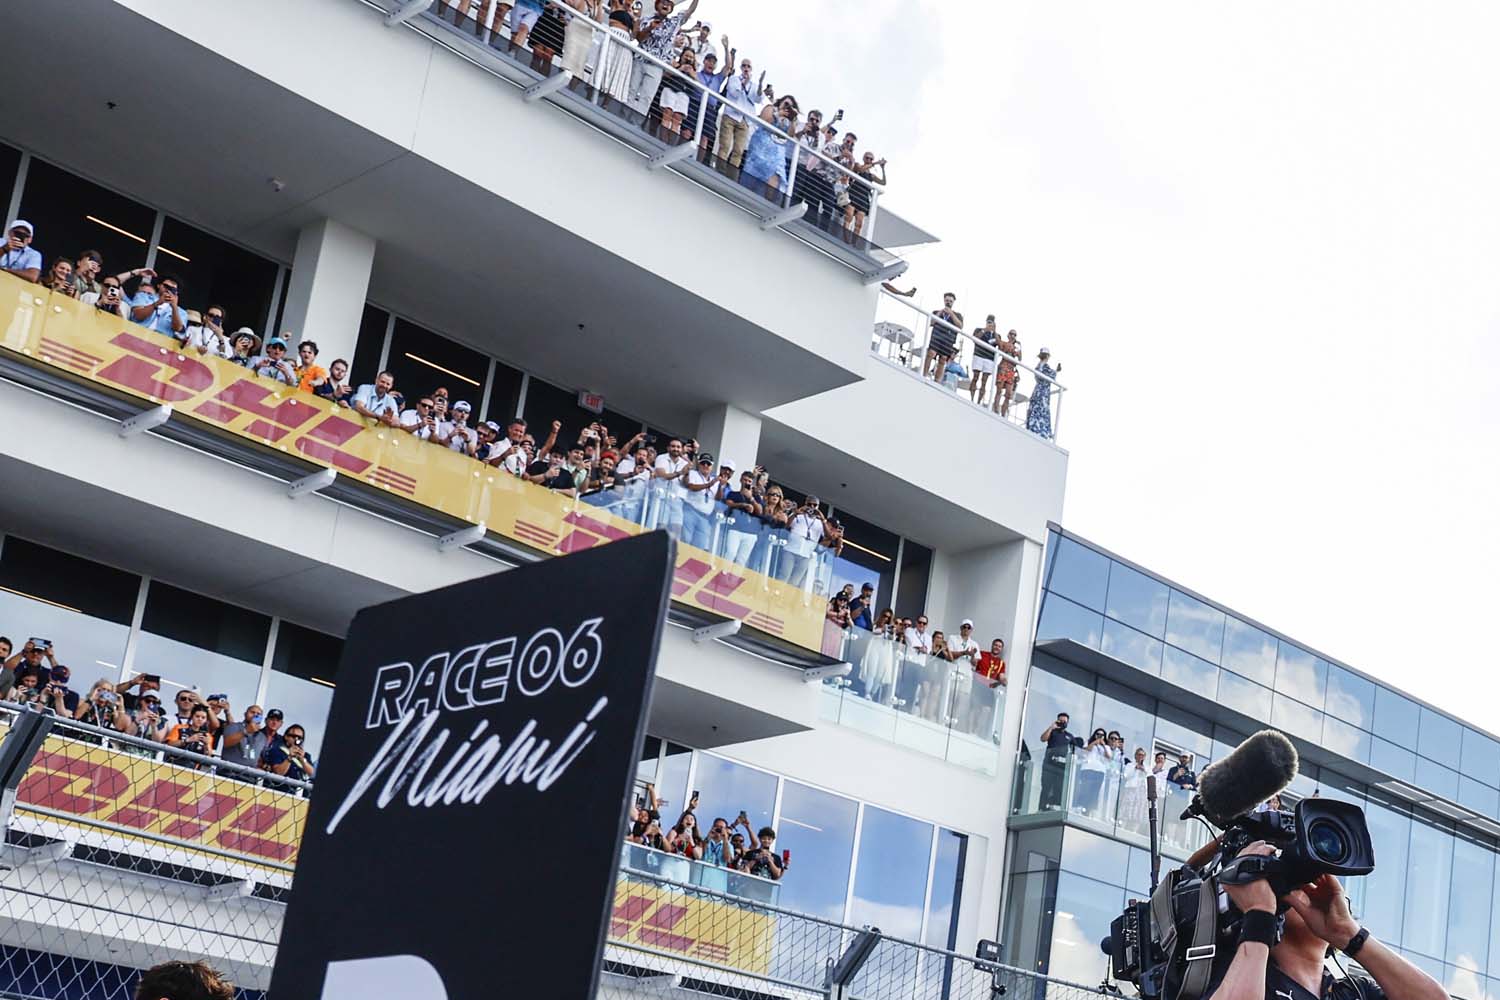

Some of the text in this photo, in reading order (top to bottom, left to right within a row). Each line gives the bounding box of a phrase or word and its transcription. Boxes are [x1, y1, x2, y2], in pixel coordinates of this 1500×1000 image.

[96, 332, 371, 474] DHL
[15, 751, 298, 861] DHL
[326, 696, 608, 835] Miami
